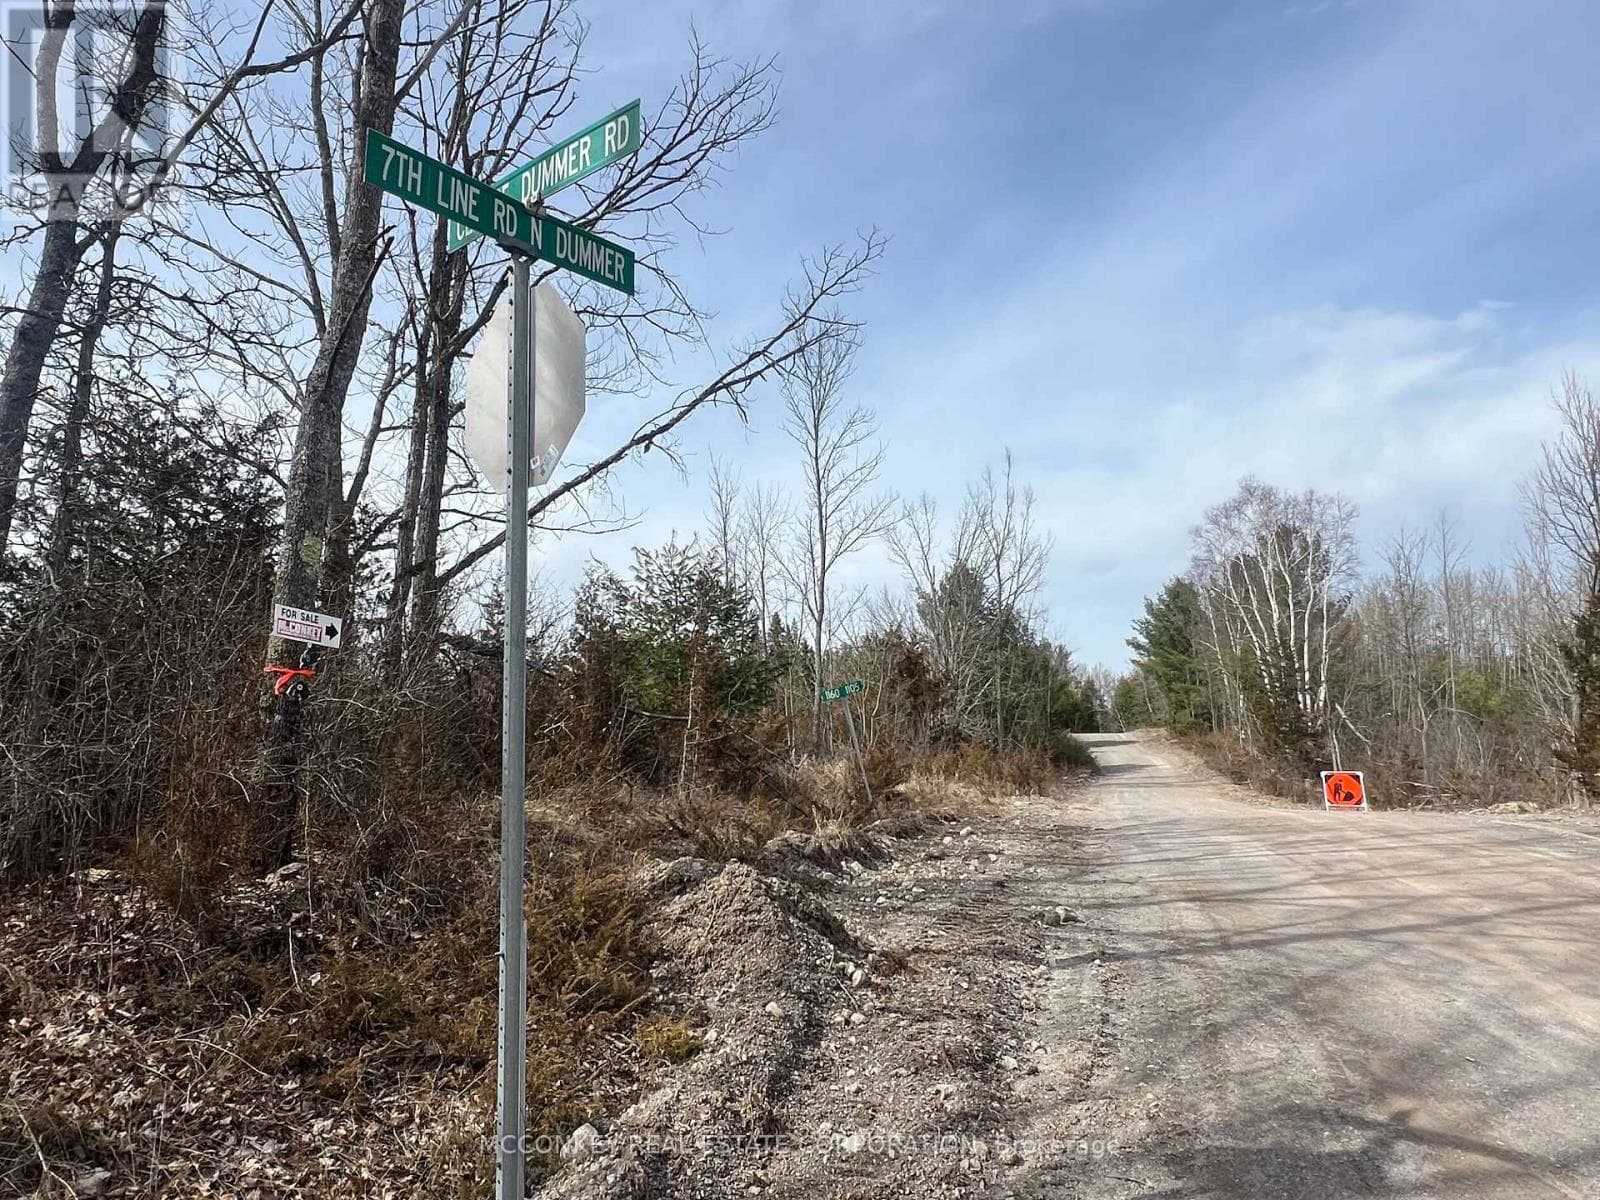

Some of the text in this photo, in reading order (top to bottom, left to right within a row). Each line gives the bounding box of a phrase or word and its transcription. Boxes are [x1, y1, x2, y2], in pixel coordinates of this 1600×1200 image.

[521, 115, 629, 203] DUMMER RD
[381, 145, 422, 196] 7TH
[437, 165, 480, 223] LINE
[493, 199, 517, 238] RD
[531, 216, 542, 250] N
[556, 227, 625, 285] DUMMER
[281, 607, 320, 625] FOR SALE
